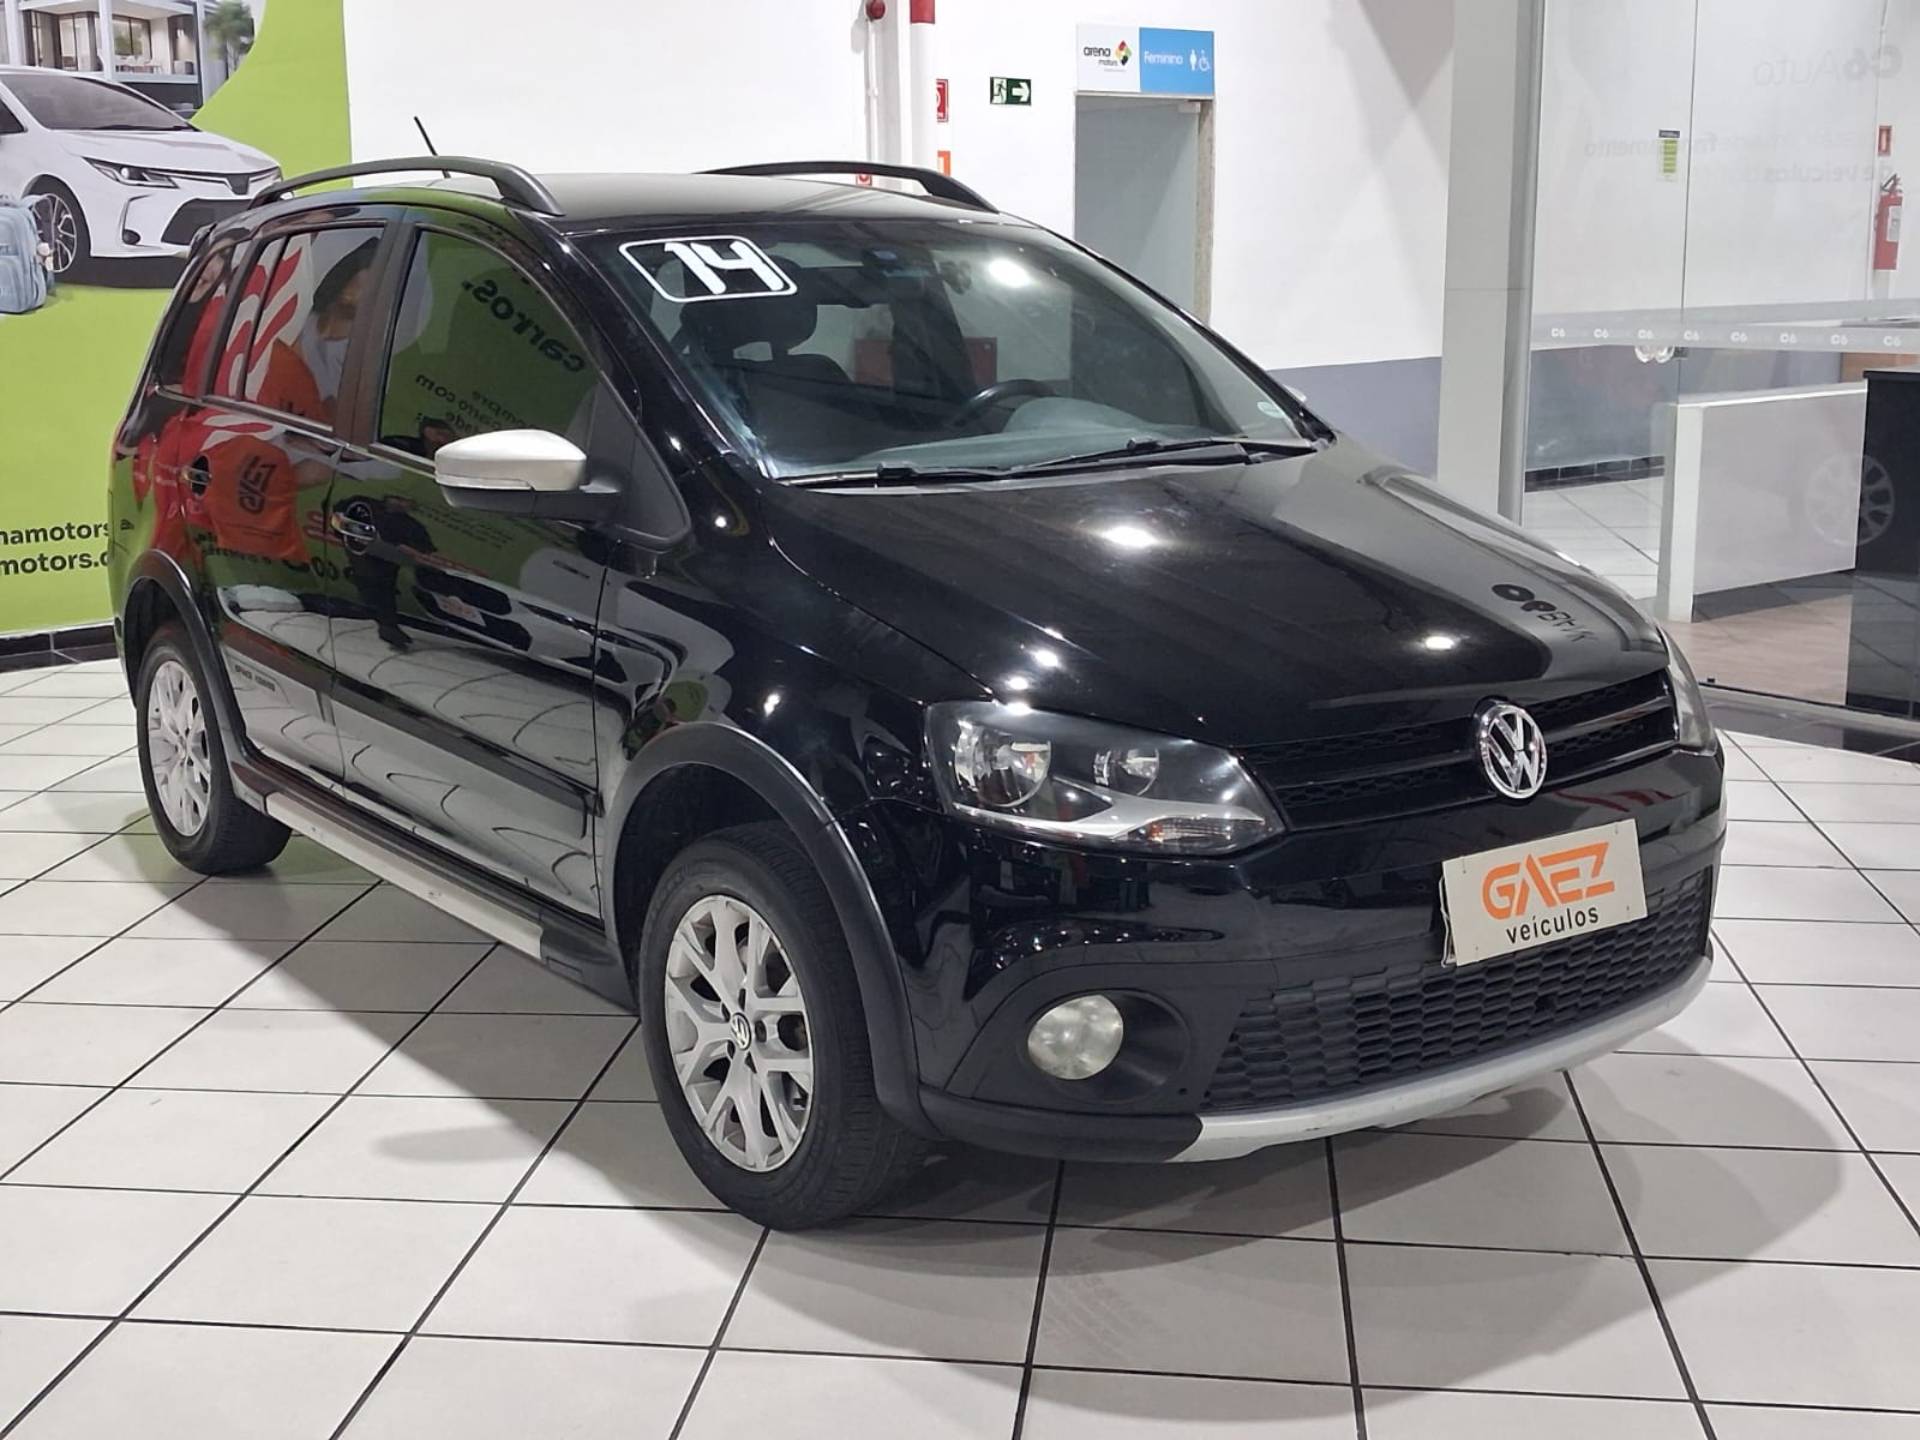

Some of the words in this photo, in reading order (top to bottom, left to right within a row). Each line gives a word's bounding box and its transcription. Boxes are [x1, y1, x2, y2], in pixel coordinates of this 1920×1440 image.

[1083, 46, 1111, 57] arena
[1144, 50, 1183, 65] Feminino
[664, 240, 785, 295] 14
[1482, 841, 1616, 920] GAEZ
[1506, 906, 1600, 944] veículos
